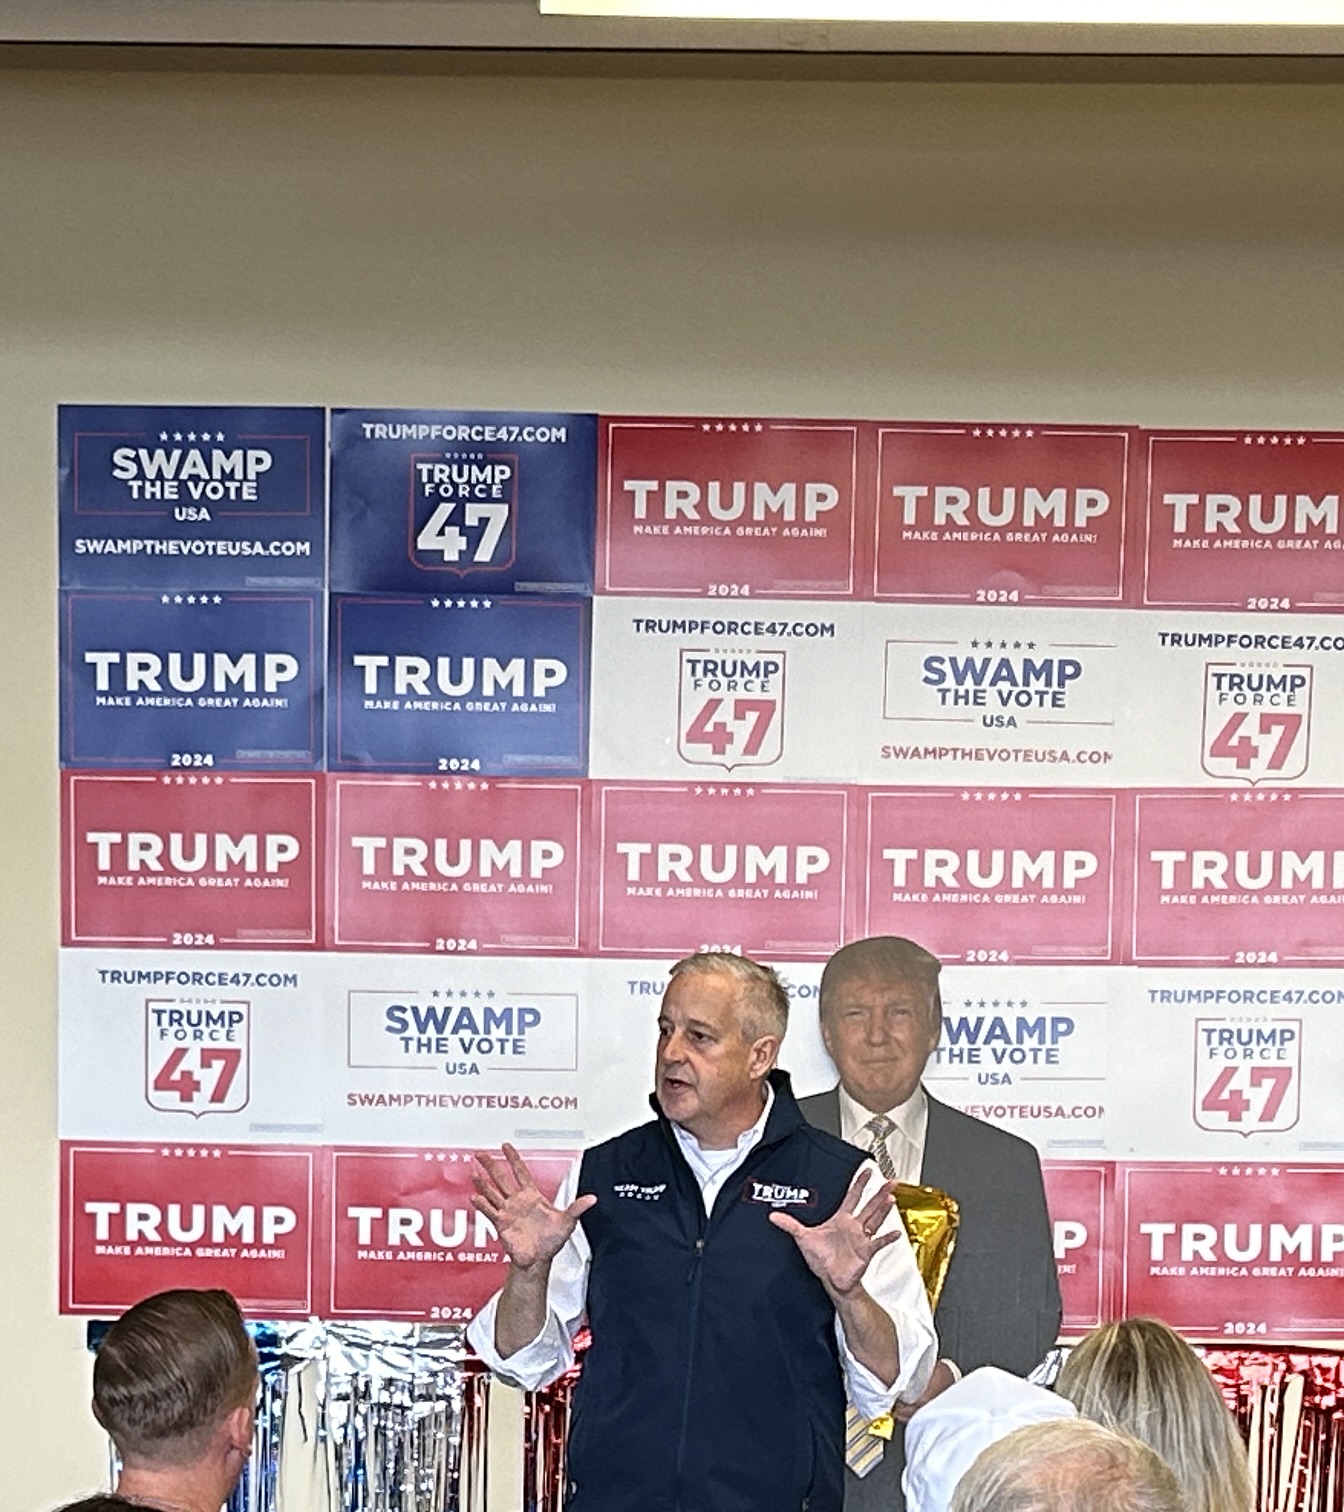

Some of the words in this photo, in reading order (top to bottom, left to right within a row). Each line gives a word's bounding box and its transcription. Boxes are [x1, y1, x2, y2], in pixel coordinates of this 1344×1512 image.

[361, 423, 567, 443] TRUMPFORCE47.COM
[112, 448, 272, 480] SWAMP
[416, 463, 511, 485] TRUMP
[128, 480, 179, 499] THE
[187, 481, 258, 501] VOTE
[424, 484, 503, 498] FORCE
[623, 480, 839, 522] TRUMP
[893, 485, 1109, 527] TRUMP
[174, 507, 211, 521] USA
[416, 502, 509, 563] 47
[902, 531, 938, 541] MAKE
[943, 531, 1001, 542] AMERICA
[1006, 532, 1047, 542] GREAT
[75, 539, 310, 556] SWAMPTHEVOTEUSA.COM
[708, 584, 750, 596] 2024
[976, 590, 1018, 602] 2024
[1247, 597, 1291, 609] 2024
[632, 619, 835, 637] TRUMPFORCE47.COM
[85, 652, 299, 693] TRUMP
[353, 655, 568, 697] TRUMP
[686, 659, 779, 679] TRUMP
[922, 656, 1082, 688] SWAMP
[693, 679, 770, 692] FORCE
[1212, 673, 1306, 693] TRUMP
[96, 696, 131, 706] MAKE
[136, 696, 193, 707] AMERICA
[198, 698, 238, 708] GREAT
[937, 688, 987, 706] THE
[997, 690, 1066, 708] VOTE
[1219, 693, 1297, 707] FORCE
[686, 698, 776, 756] 47
[982, 715, 1018, 728] USA
[1210, 712, 1302, 770] 47
[171, 754, 214, 766] 2024
[438, 758, 481, 771] 2024
[87, 832, 300, 873] TRUMP
[352, 838, 565, 879] TRUMP
[616, 843, 830, 885] TRUMP
[883, 849, 1098, 890] TRUMP
[362, 881, 397, 891] MAKE
[401, 882, 459, 892] AMERICA
[462, 883, 504, 893] GREAT
[626, 887, 662, 896] MAKE
[666, 888, 724, 898] AMERICA
[728, 888, 769, 898] GREAT
[172, 933, 215, 946] 2024
[435, 937, 478, 951] 2024
[966, 951, 1009, 962] 2024
[1235, 951, 1279, 963] 2024
[97, 969, 298, 987] TRUMPFORCE47.COM
[152, 1009, 244, 1028] TRUMP
[385, 1005, 541, 1036] SWAMP
[160, 1028, 236, 1042] FORCE
[943, 1016, 1075, 1045] WAMP
[1201, 1028, 1295, 1047] TRUMP
[400, 1036, 448, 1054] THE
[459, 1038, 526, 1055] VOTE
[1209, 1047, 1287, 1060] FORCE
[935, 1048, 981, 1064] THE
[992, 1048, 1060, 1064] VOTE
[153, 1047, 242, 1104] 47
[445, 1062, 481, 1075] USA
[978, 1073, 1012, 1085] USA
[347, 1093, 578, 1110] SWAMPTHEVOTEUSA.COM
[1201, 1066, 1293, 1122] 47
[752, 1183, 810, 1201] TRUMP
[84, 1202, 297, 1244] TRUMP
[358, 1250, 393, 1260] MAKE
[396, 1251, 454, 1262] AMERICA
[458, 1252, 498, 1262] GREAT
[430, 1307, 473, 1320] 2024
[1224, 1322, 1267, 1335] 2024
